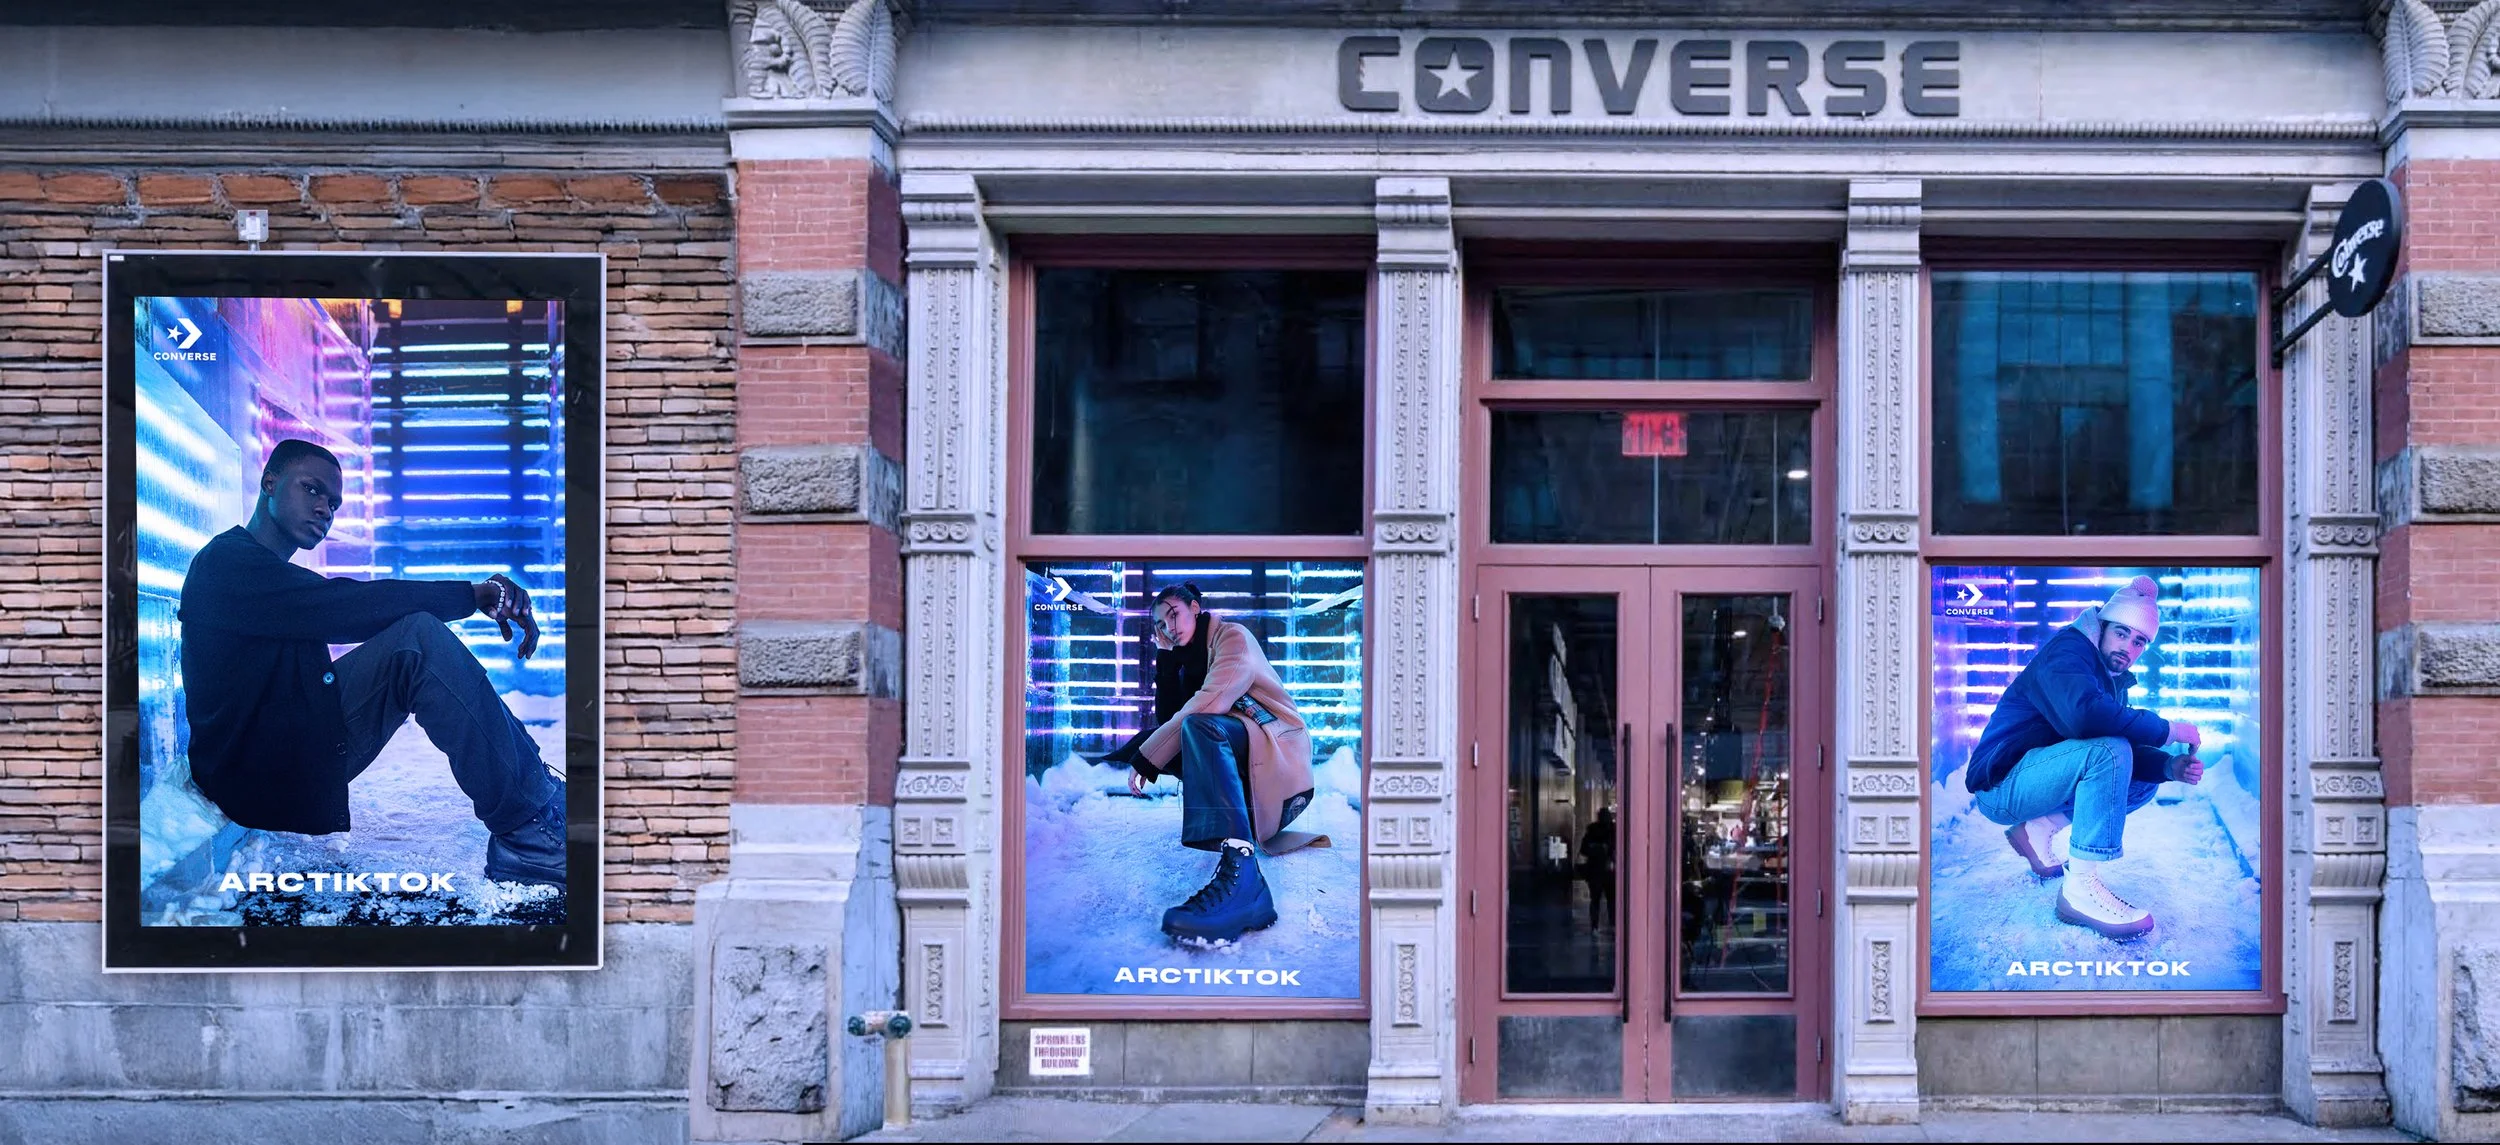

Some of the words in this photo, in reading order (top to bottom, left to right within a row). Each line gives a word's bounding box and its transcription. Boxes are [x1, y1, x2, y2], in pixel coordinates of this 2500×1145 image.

[1337, 35, 1961, 117] CONVERSE
[2331, 218, 2385, 279] Converse
[153, 351, 217, 361] CONVERSE
[1034, 603, 1083, 611] CONVERSE
[218, 872, 456, 892] ARCTIKTOK
[1113, 967, 1301, 986] ARCTIKTOK
[2006, 961, 2191, 977] ARCTIKTOK
